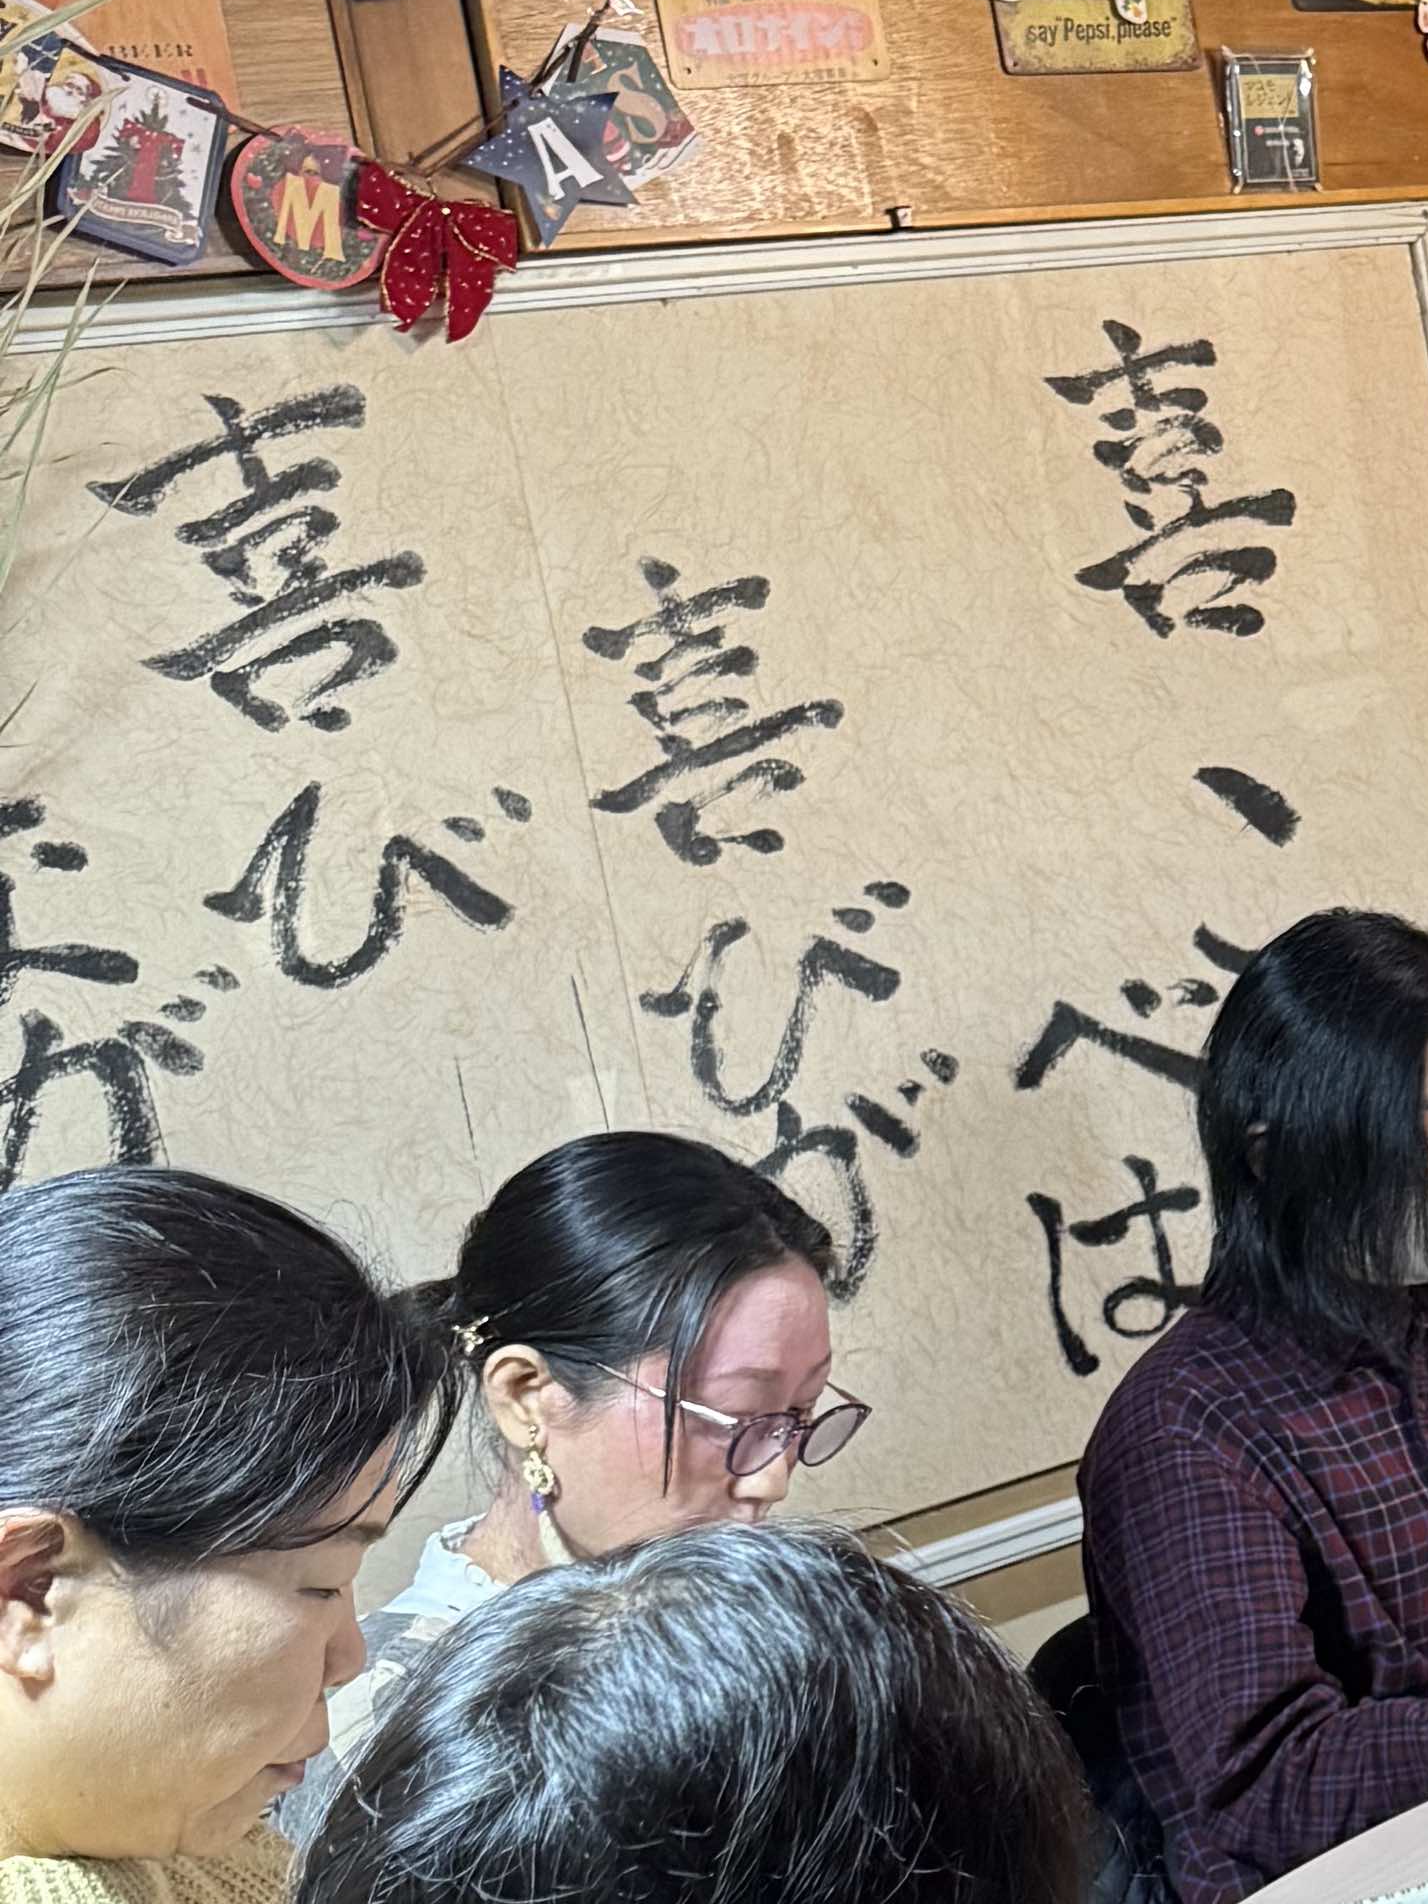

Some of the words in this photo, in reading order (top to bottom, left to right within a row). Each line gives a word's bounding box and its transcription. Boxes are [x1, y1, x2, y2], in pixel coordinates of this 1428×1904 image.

[1025, 23, 1057, 47] say
[526, 116, 604, 201] A
[273, 171, 346, 263] M
